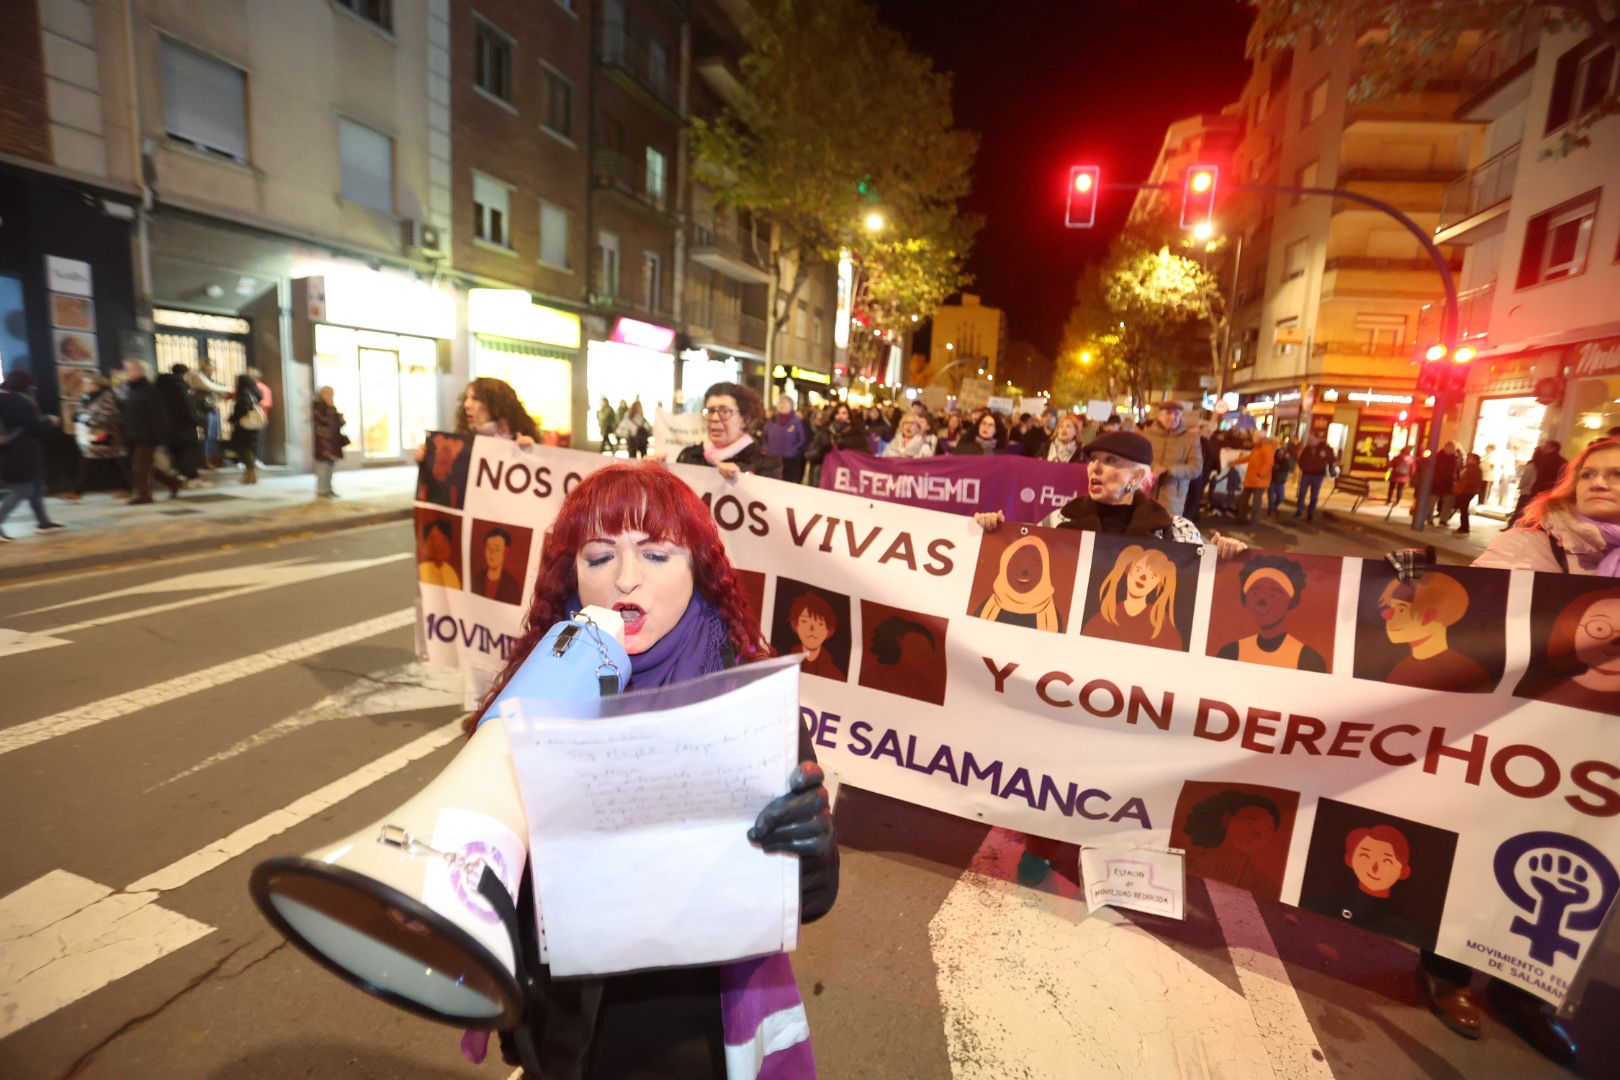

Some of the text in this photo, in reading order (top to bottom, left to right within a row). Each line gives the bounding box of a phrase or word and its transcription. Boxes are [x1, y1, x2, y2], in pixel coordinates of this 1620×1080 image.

[476, 458, 552, 498] NOS
[786, 507, 956, 577] VIVAS
[859, 470, 980, 505] FEMINISMO
[982, 656, 1620, 817] Y CON DERECHOS
[847, 721, 1152, 830] SALAMANCA
[1466, 940, 1544, 977] MOVIMIENTO
[1488, 959, 1504, 971] DE
